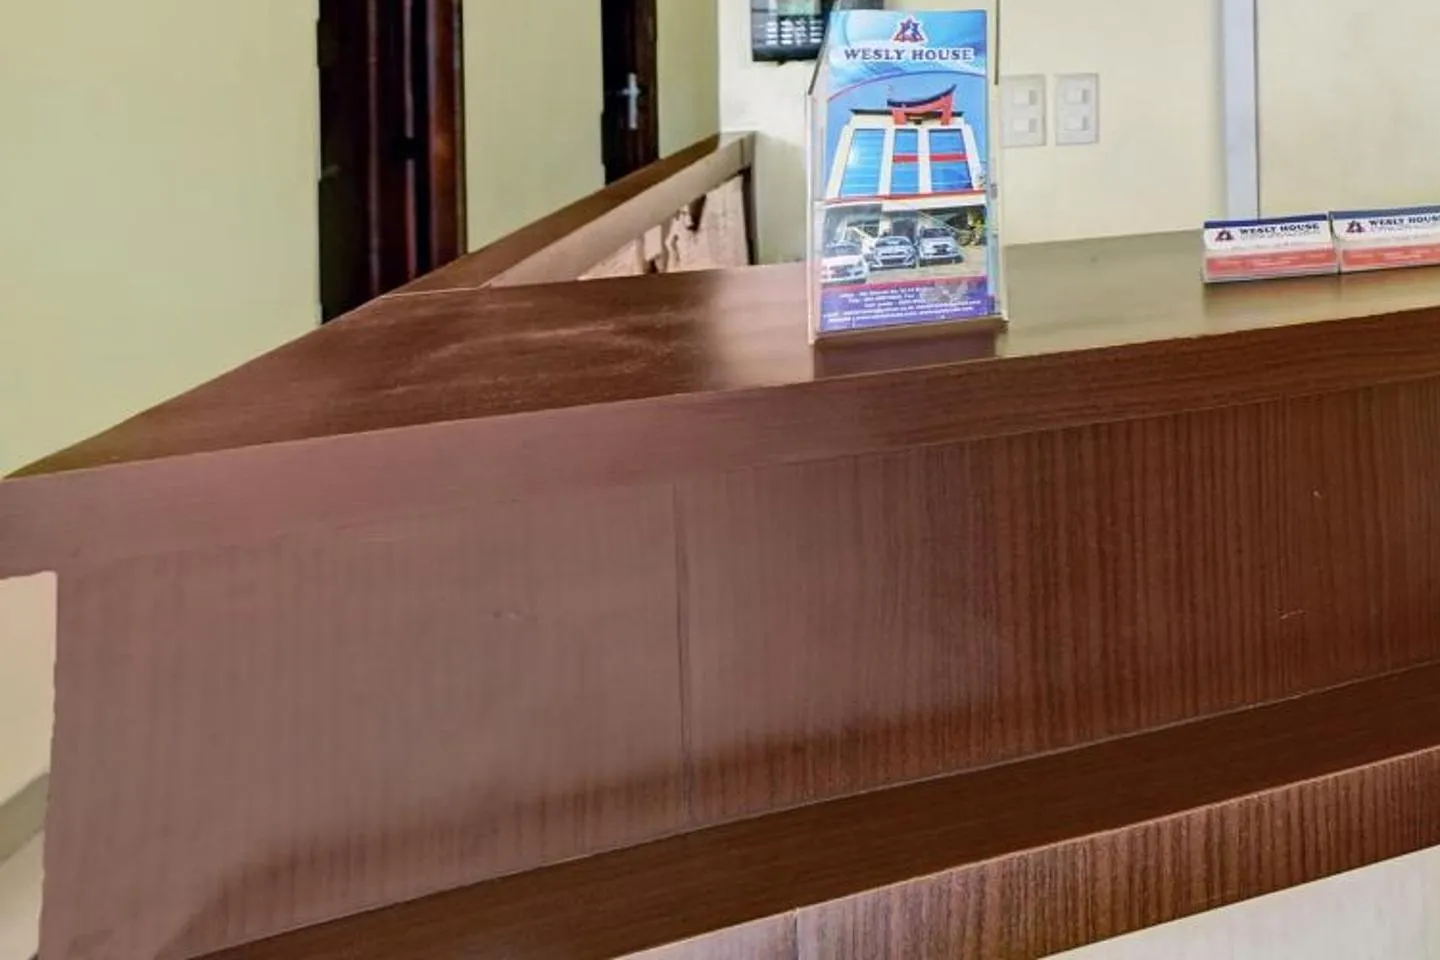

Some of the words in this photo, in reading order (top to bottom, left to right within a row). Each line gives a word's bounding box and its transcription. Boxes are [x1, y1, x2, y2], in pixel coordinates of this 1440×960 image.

[844, 48, 905, 60] WESLY
[911, 48, 973, 60] HOUSE
[1280, 223, 1320, 231] HOUSE
